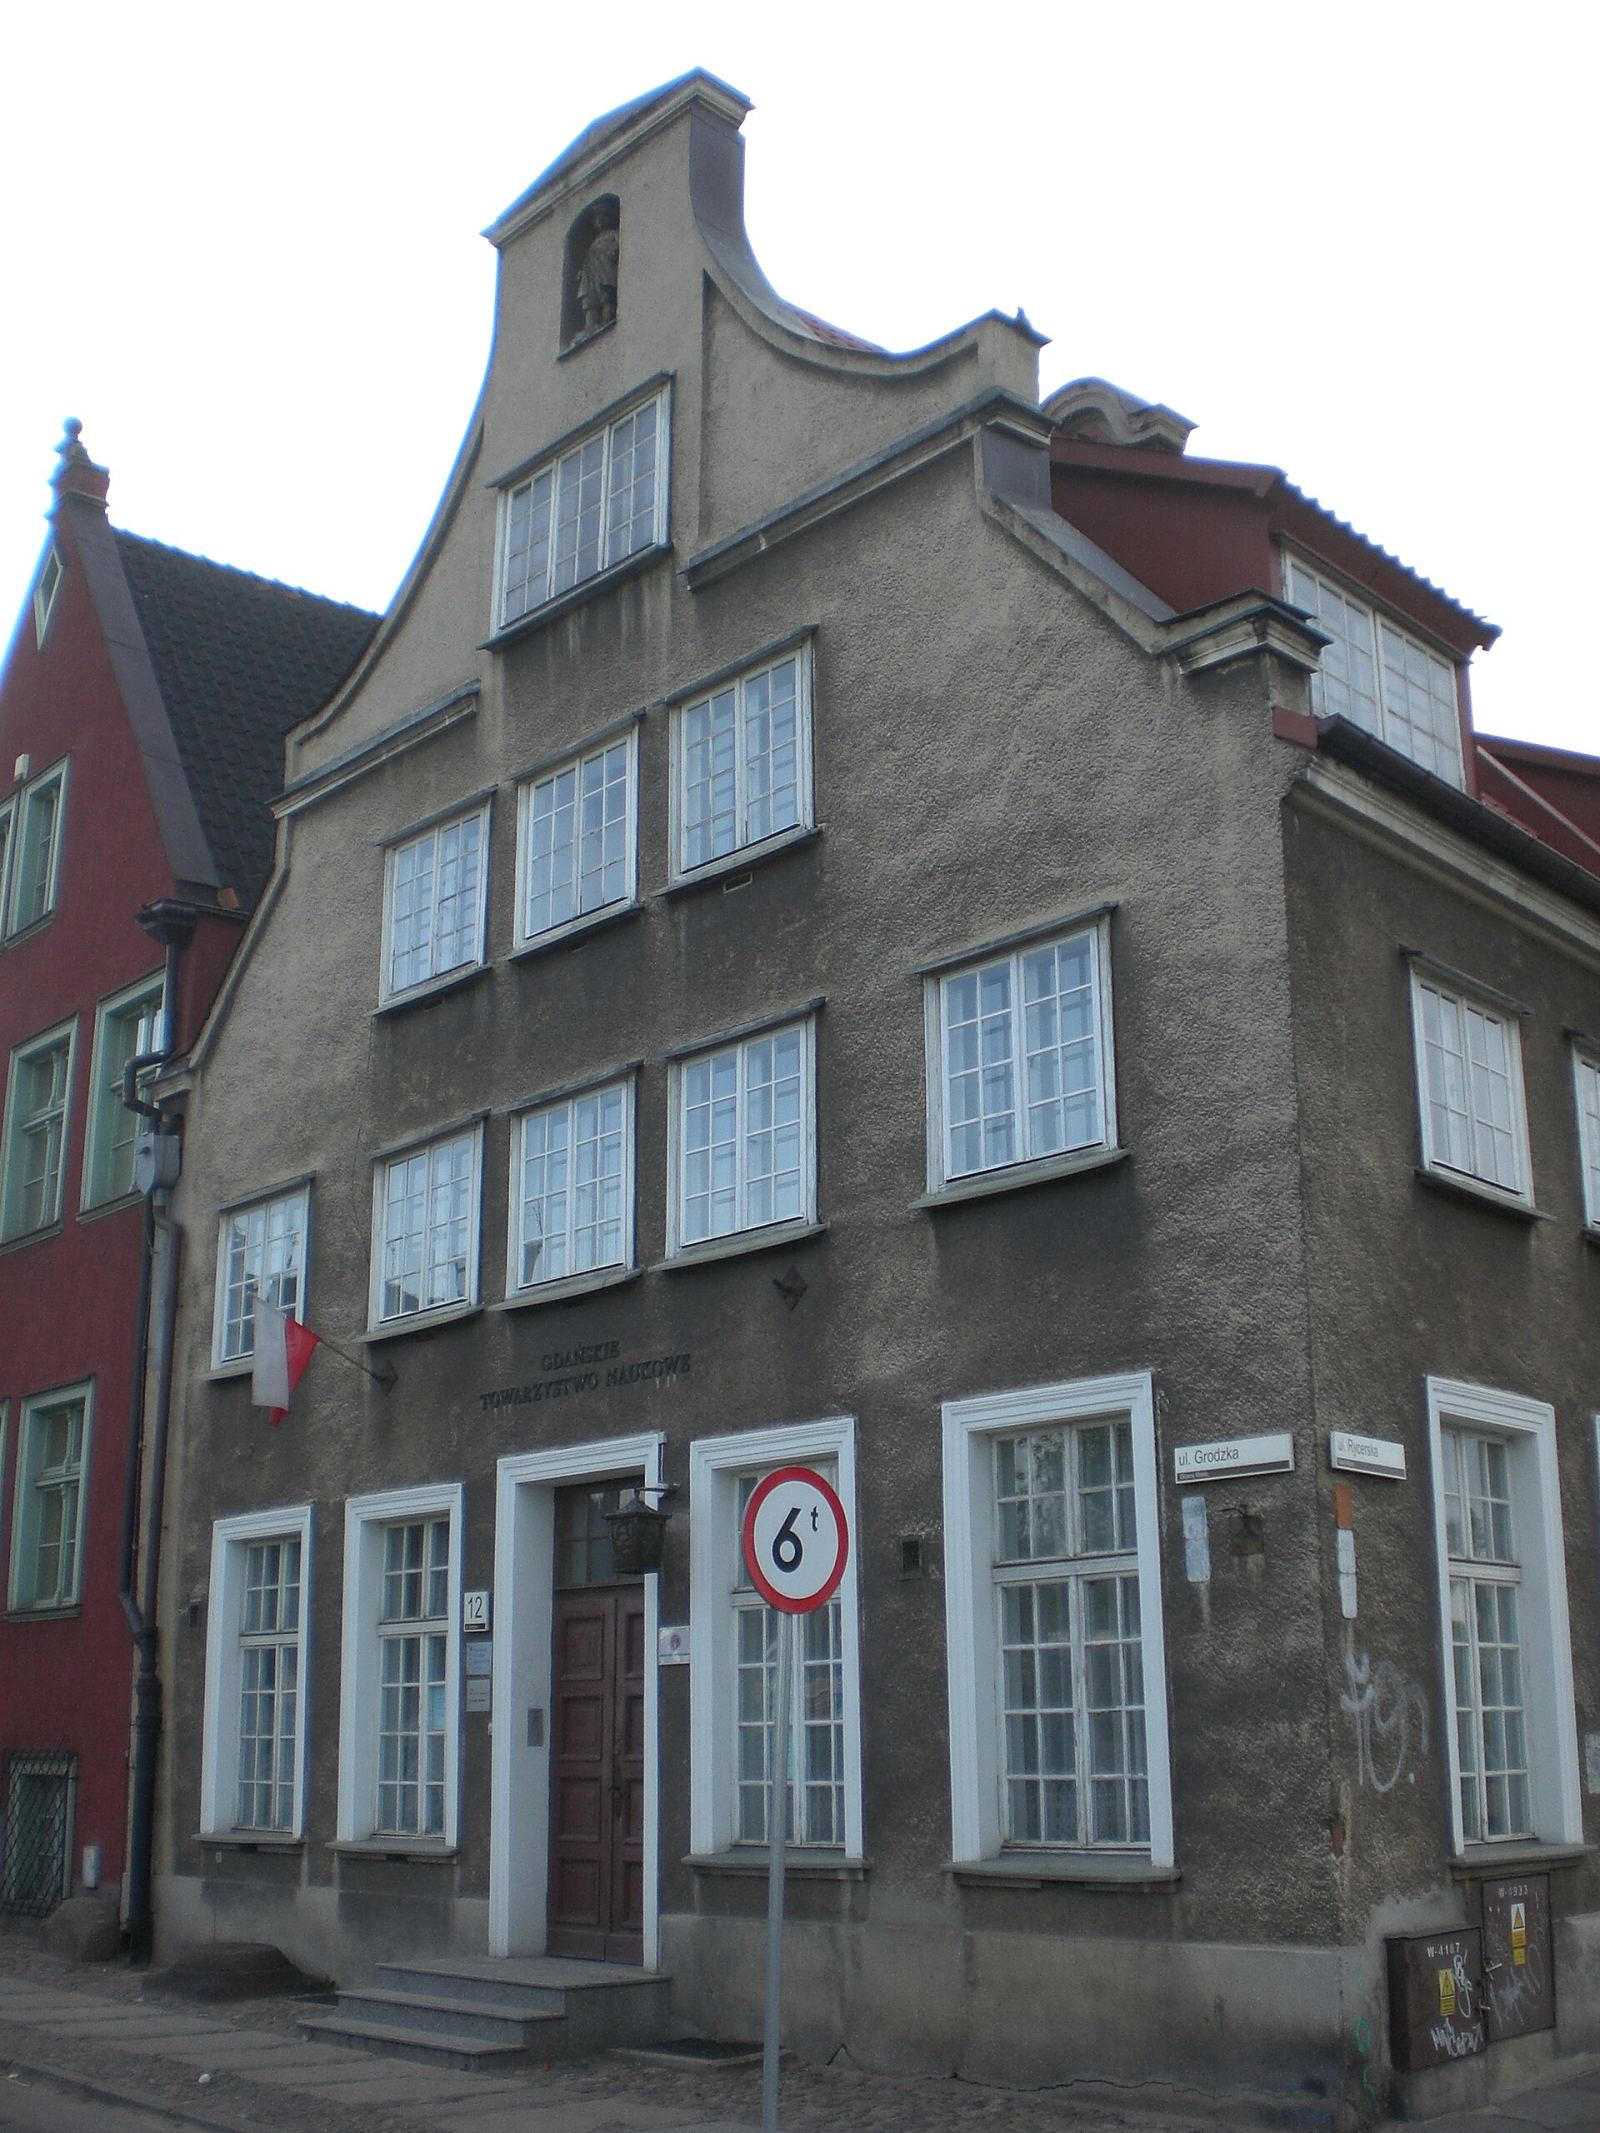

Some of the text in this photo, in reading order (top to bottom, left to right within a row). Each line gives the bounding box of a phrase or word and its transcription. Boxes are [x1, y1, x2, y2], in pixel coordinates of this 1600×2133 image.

[479, 1353, 691, 1410] TOWARZYSTWO NAUKOWE
[1179, 1447, 1239, 1466] ul. Grodzka
[468, 1596, 483, 1619] 12
